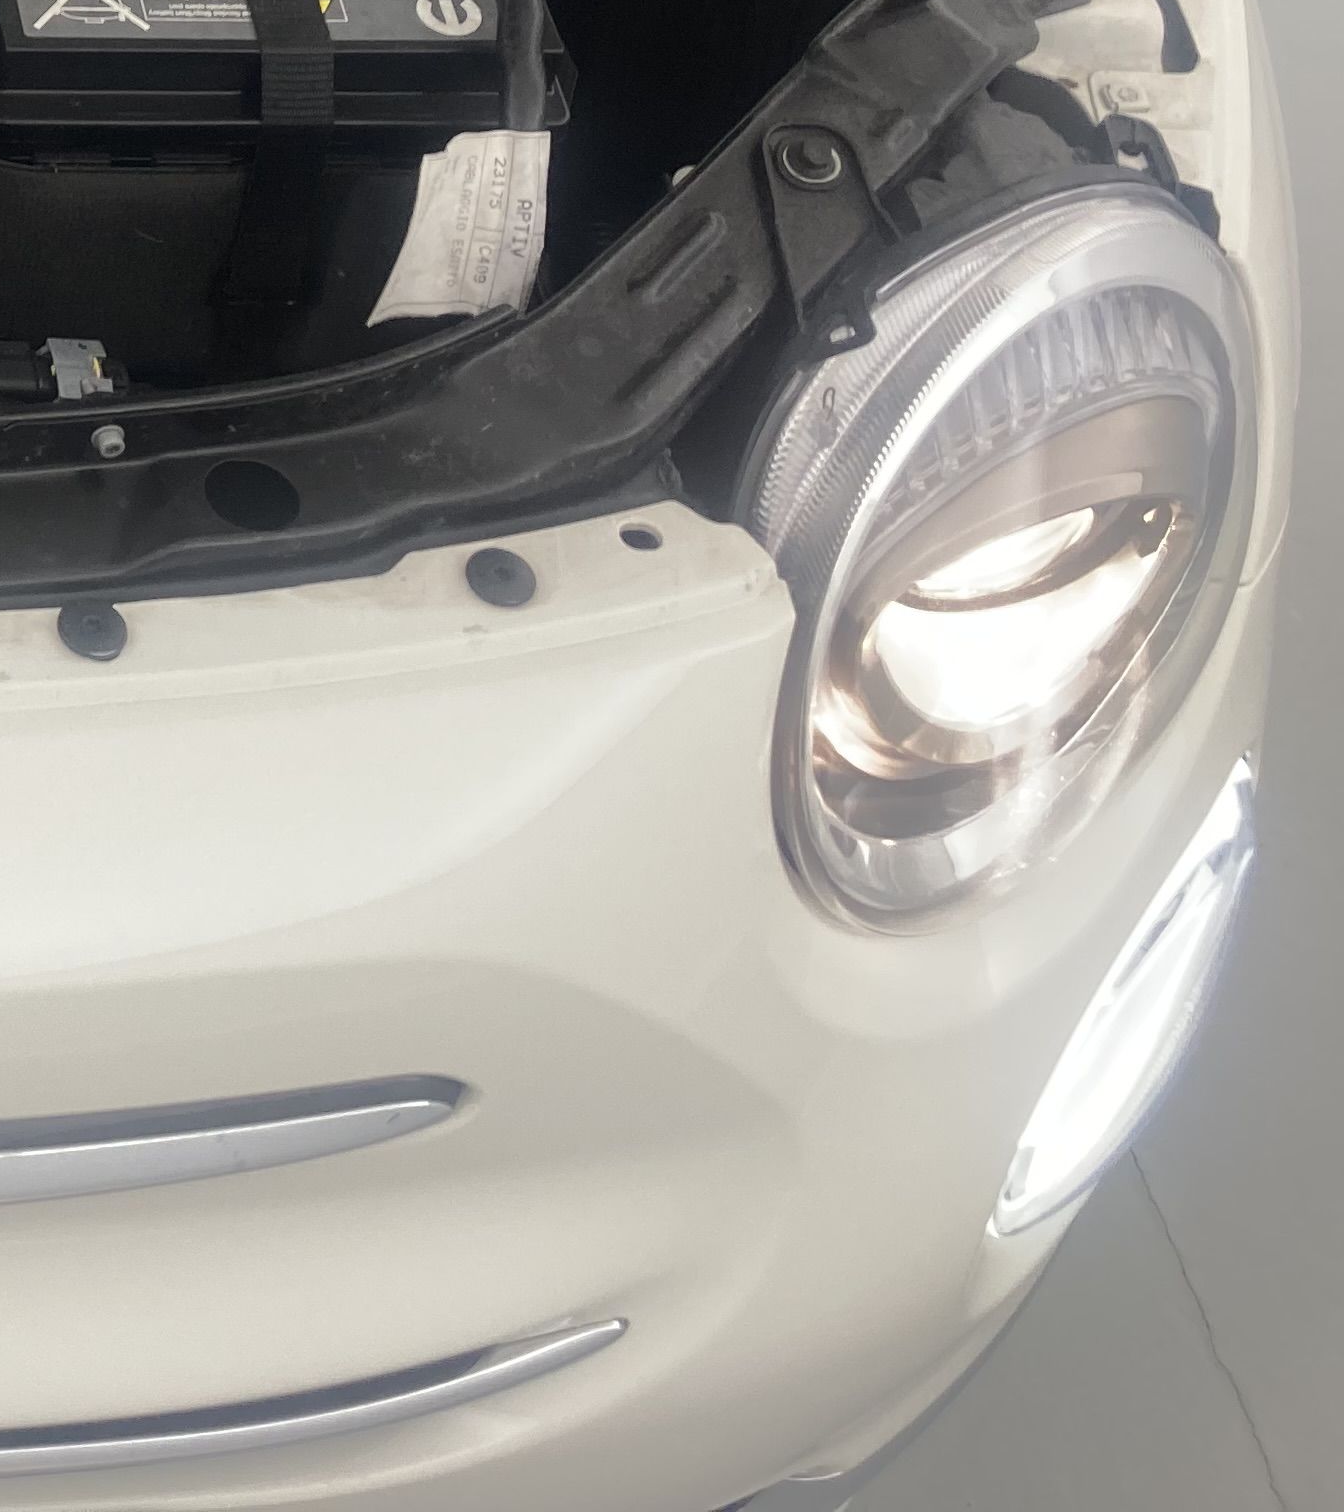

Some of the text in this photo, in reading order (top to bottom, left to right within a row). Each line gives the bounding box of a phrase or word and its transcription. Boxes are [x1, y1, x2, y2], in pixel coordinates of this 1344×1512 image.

[489, 157, 507, 210] 23175
[511, 198, 533, 258] APTIV
[473, 245, 492, 285] C409
